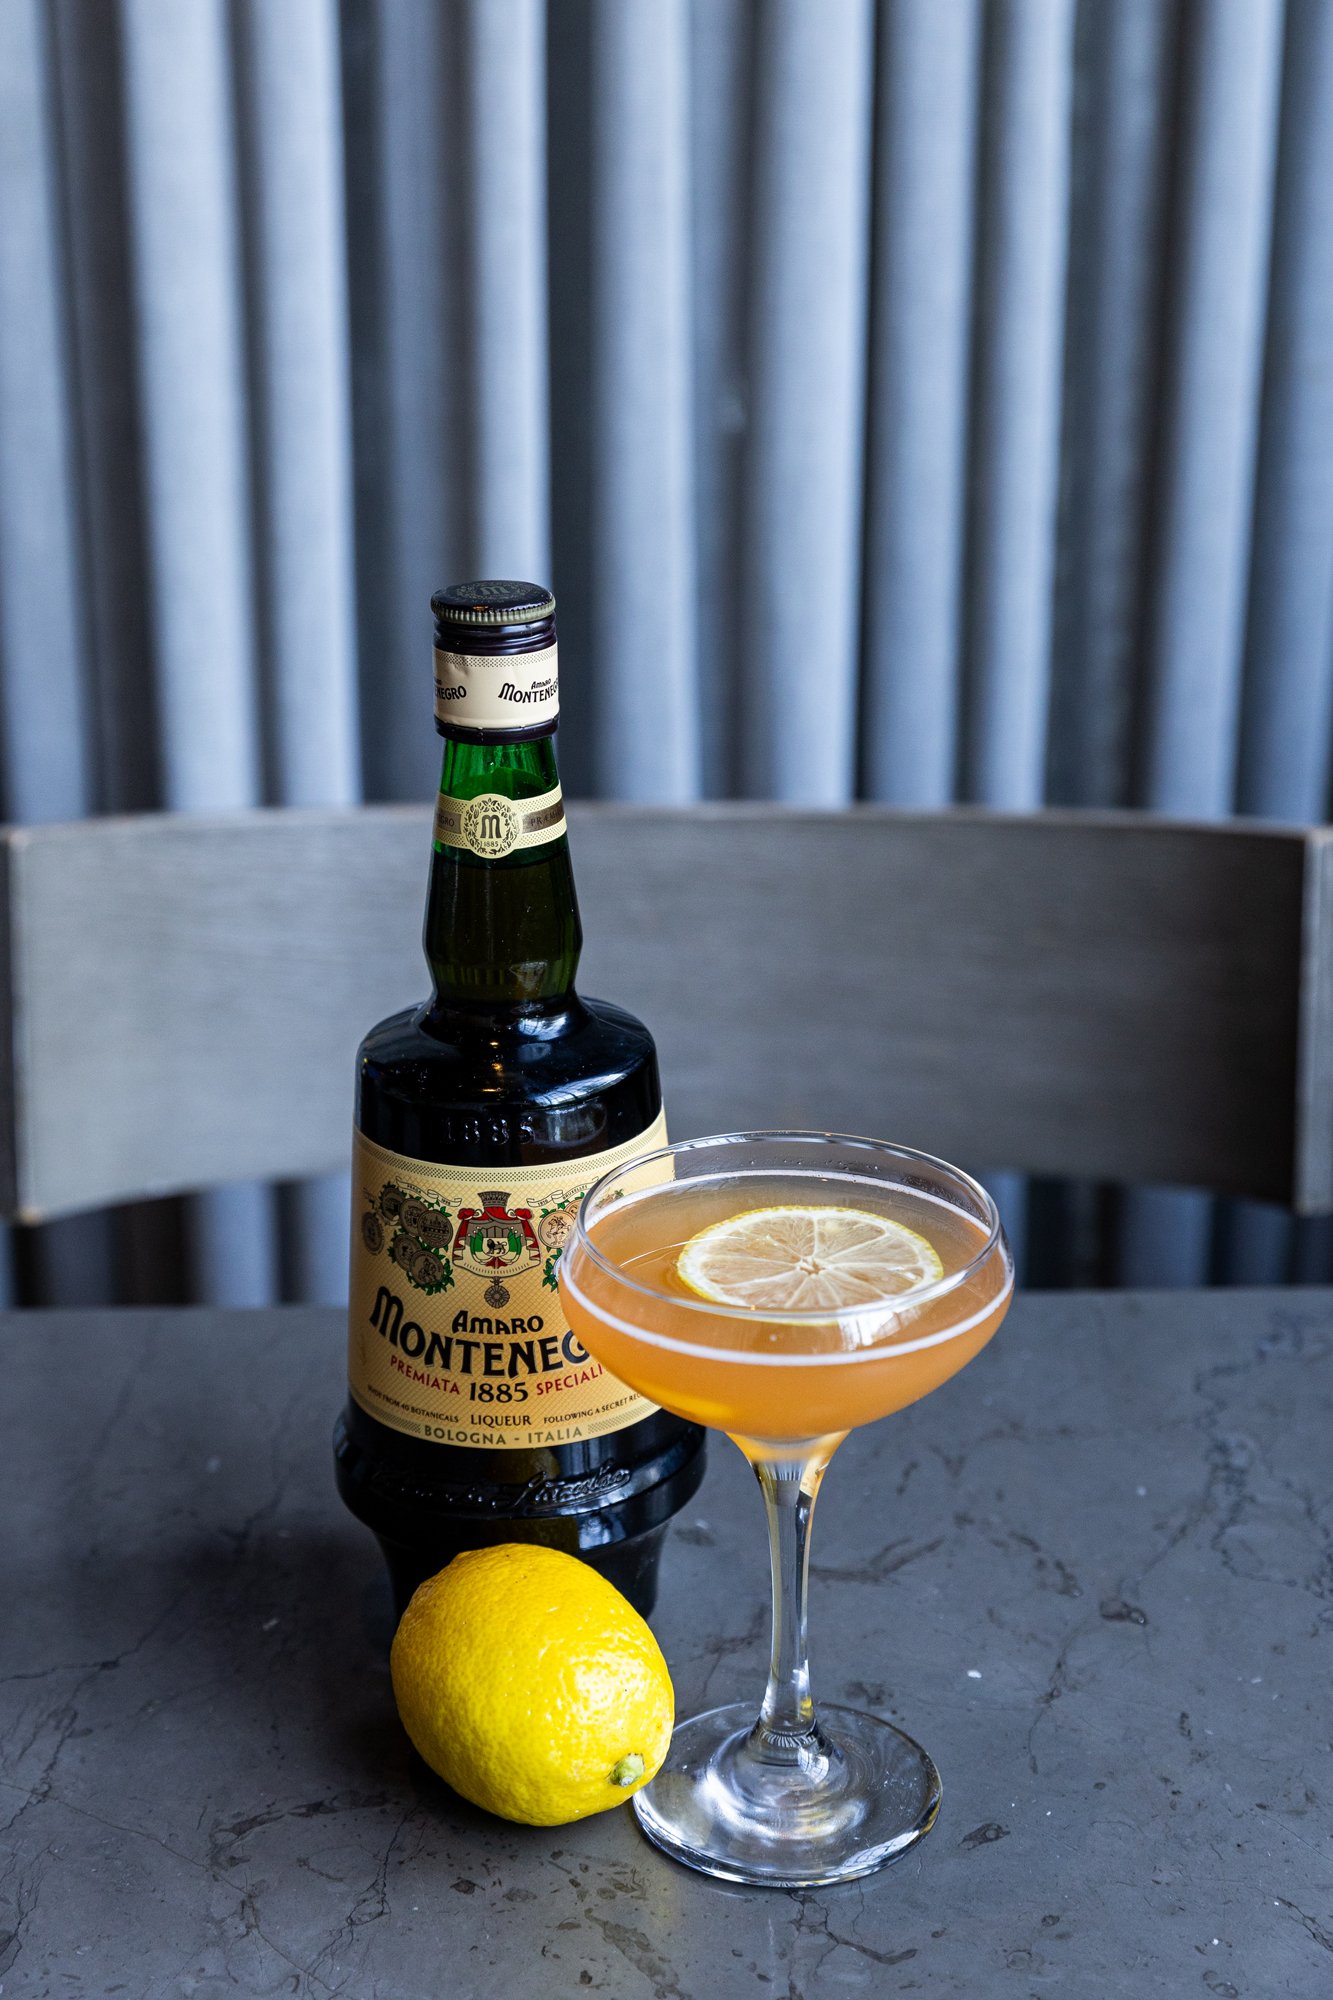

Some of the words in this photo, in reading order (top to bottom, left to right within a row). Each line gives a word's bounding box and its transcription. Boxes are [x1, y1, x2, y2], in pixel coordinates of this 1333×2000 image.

[480, 814, 502, 839] M
[480, 840, 499, 848] 1885
[390, 1355, 460, 1395] PREMIATA
[469, 1382, 529, 1404] 1885
[382, 1394, 400, 1407] FROM
[410, 1407, 459, 1424] BOTANICALS
[544, 1408, 594, 1424] FOLLOWING
[601, 1397, 628, 1412] SECRET
[471, 1415, 532, 1428] LIQUEUR
[424, 1425, 507, 1445] BOLOGNA
[528, 1427, 583, 1443] ITALIA
